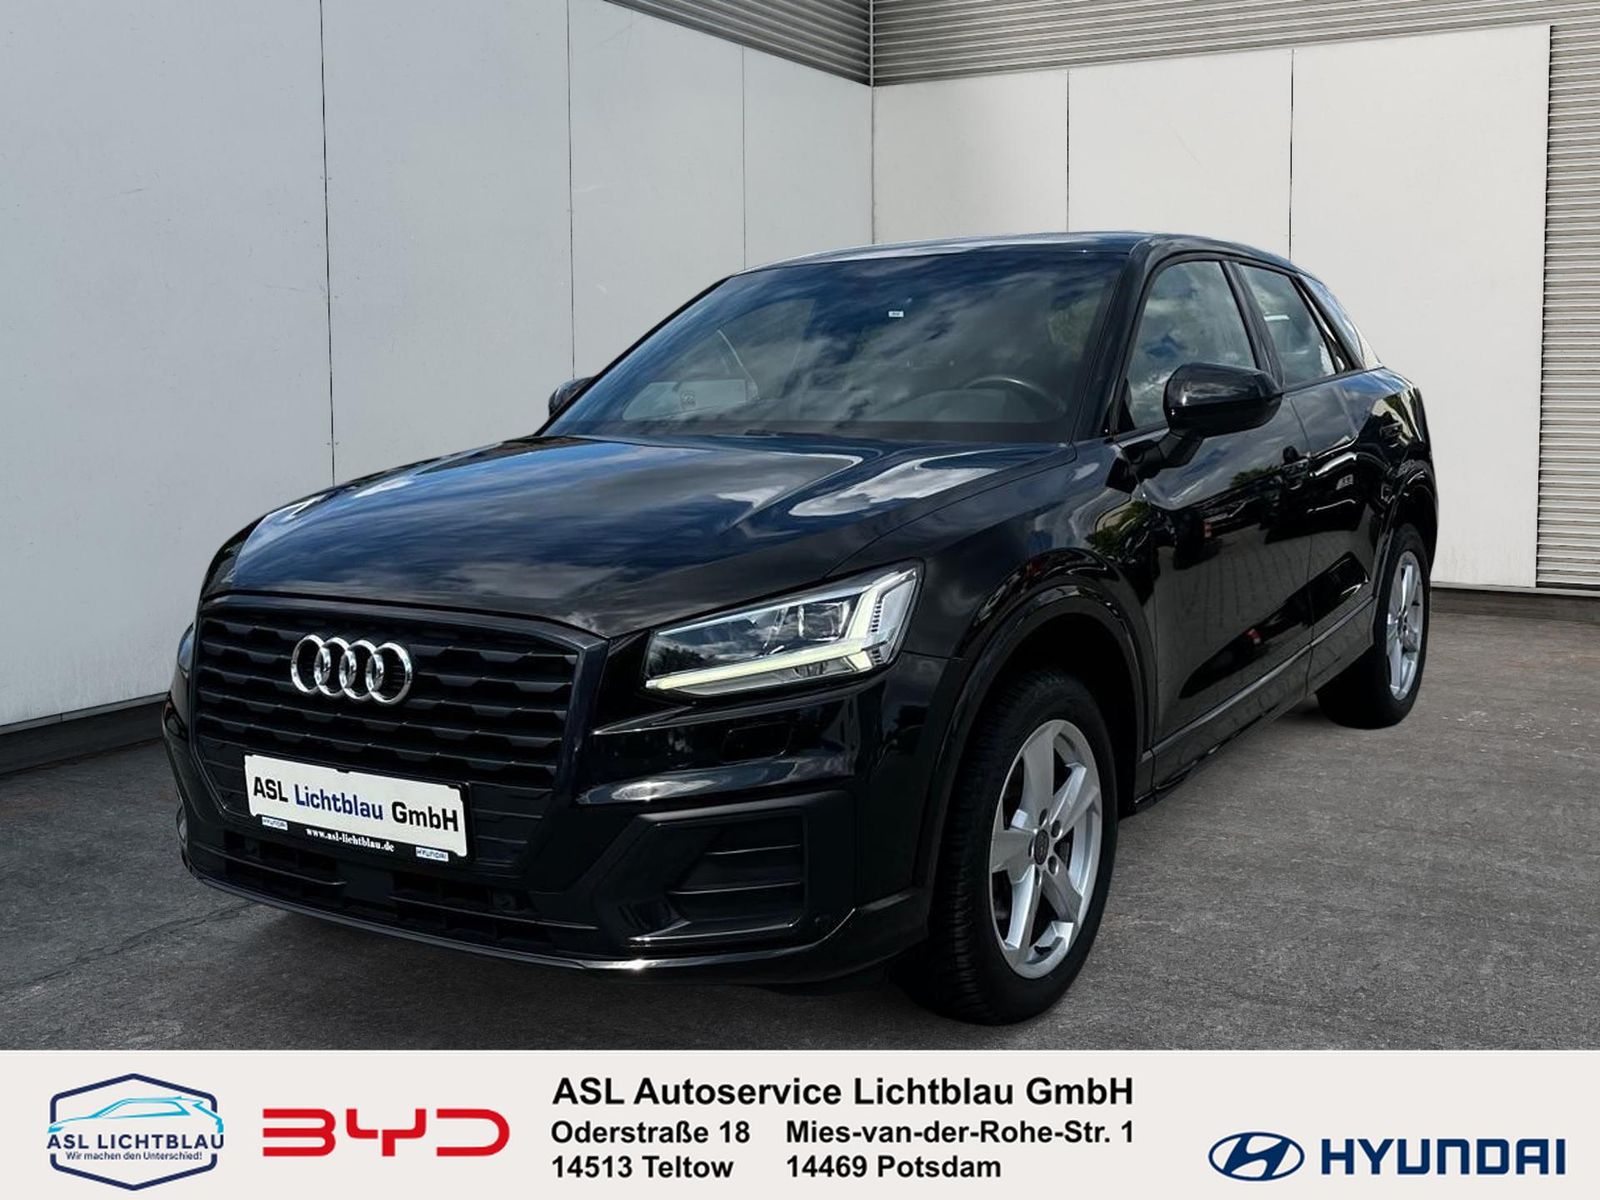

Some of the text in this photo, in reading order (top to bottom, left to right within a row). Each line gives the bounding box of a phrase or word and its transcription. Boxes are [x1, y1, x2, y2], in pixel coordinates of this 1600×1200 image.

[253, 776, 459, 832] ASL Lichtblau GmbH
[305, 828, 395, 852] www.asl-lichtblau.de
